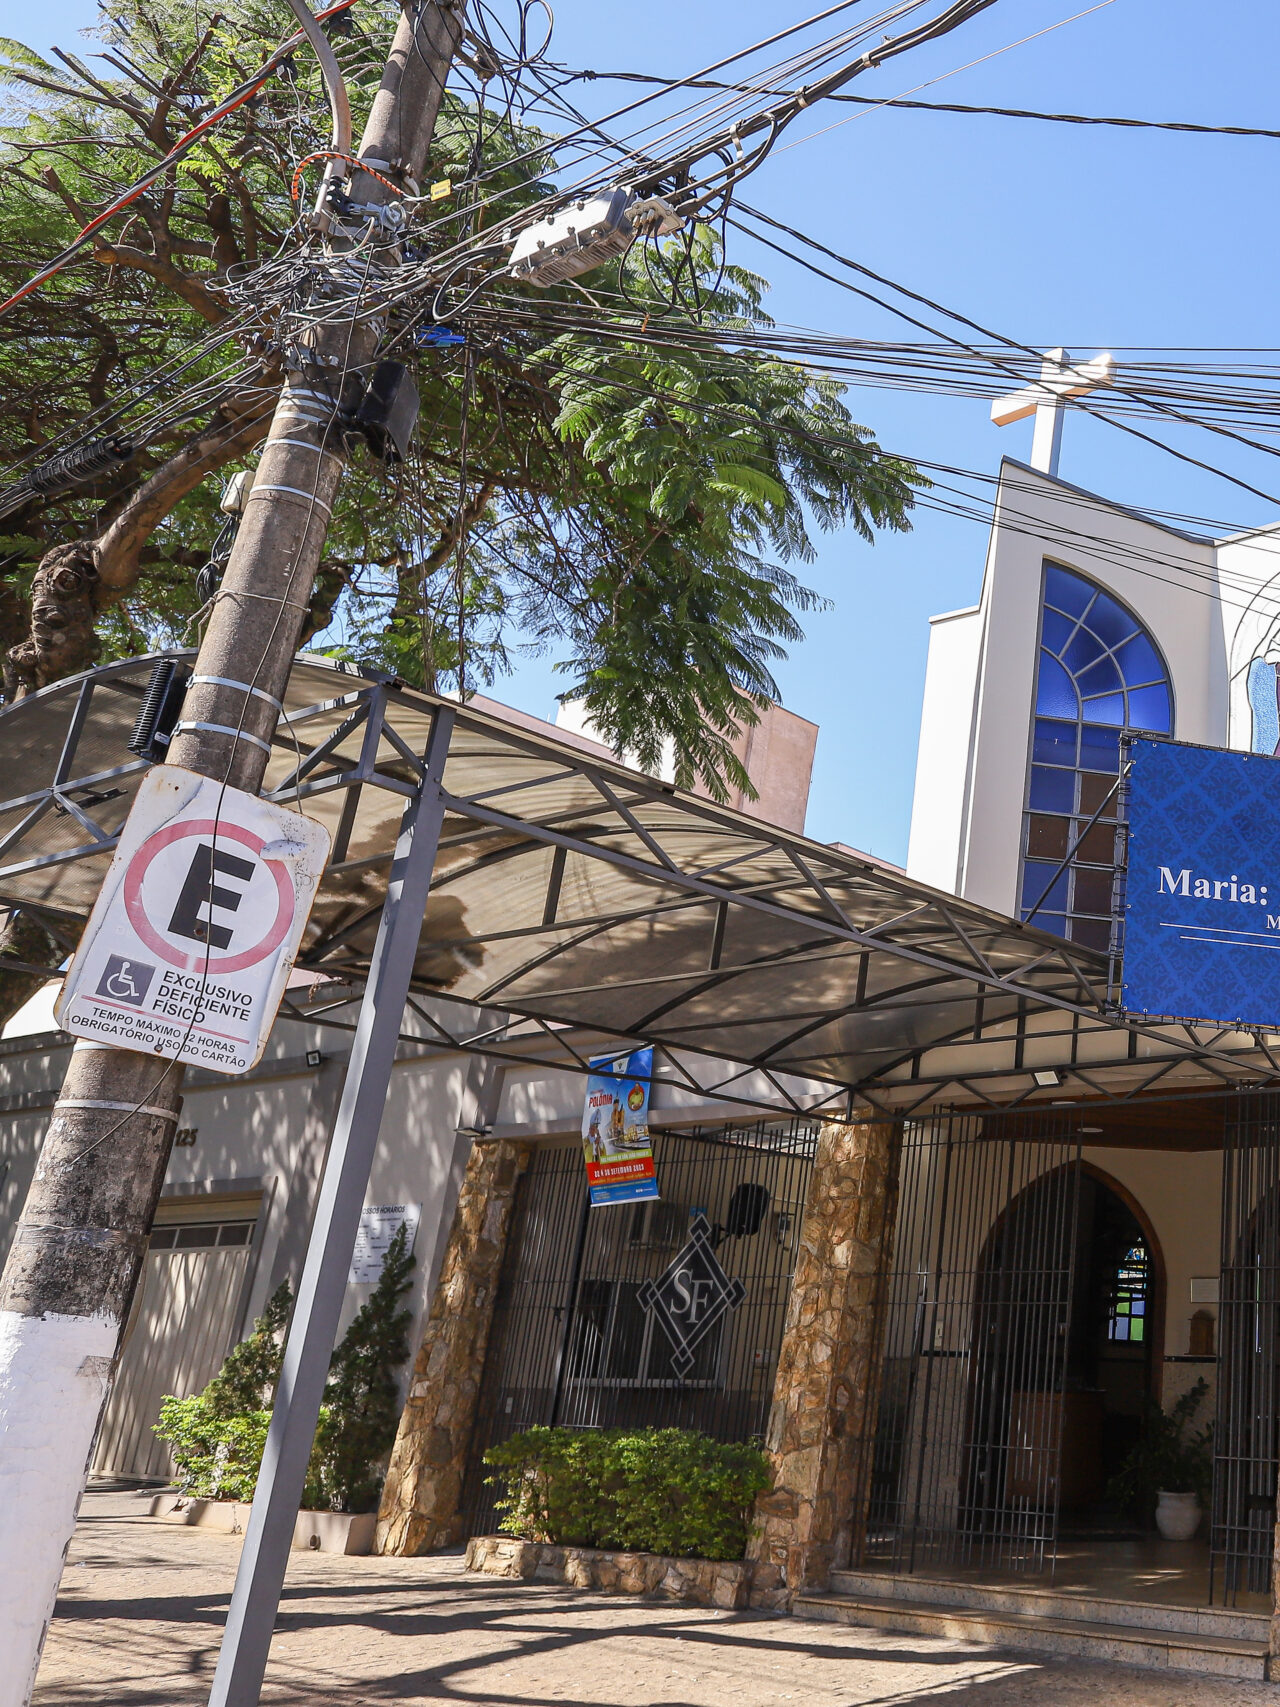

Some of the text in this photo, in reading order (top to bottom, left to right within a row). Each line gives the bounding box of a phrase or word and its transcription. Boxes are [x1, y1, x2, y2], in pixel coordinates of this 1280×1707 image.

[167, 843, 256, 951] E
[1157, 866, 1268, 906] Maria:
[157, 984, 251, 1022] DEFICIENTE
[163, 970, 253, 1007] EXCLUSIVO
[92, 1007, 236, 1054] TEMPO MÁXIMO 02 HORAS
[152, 998, 206, 1025] FÍSICO
[71, 1014, 246, 1068] OBRIGATÓRIO USO DO CARTÃO
[669, 1268, 714, 1324] SF
